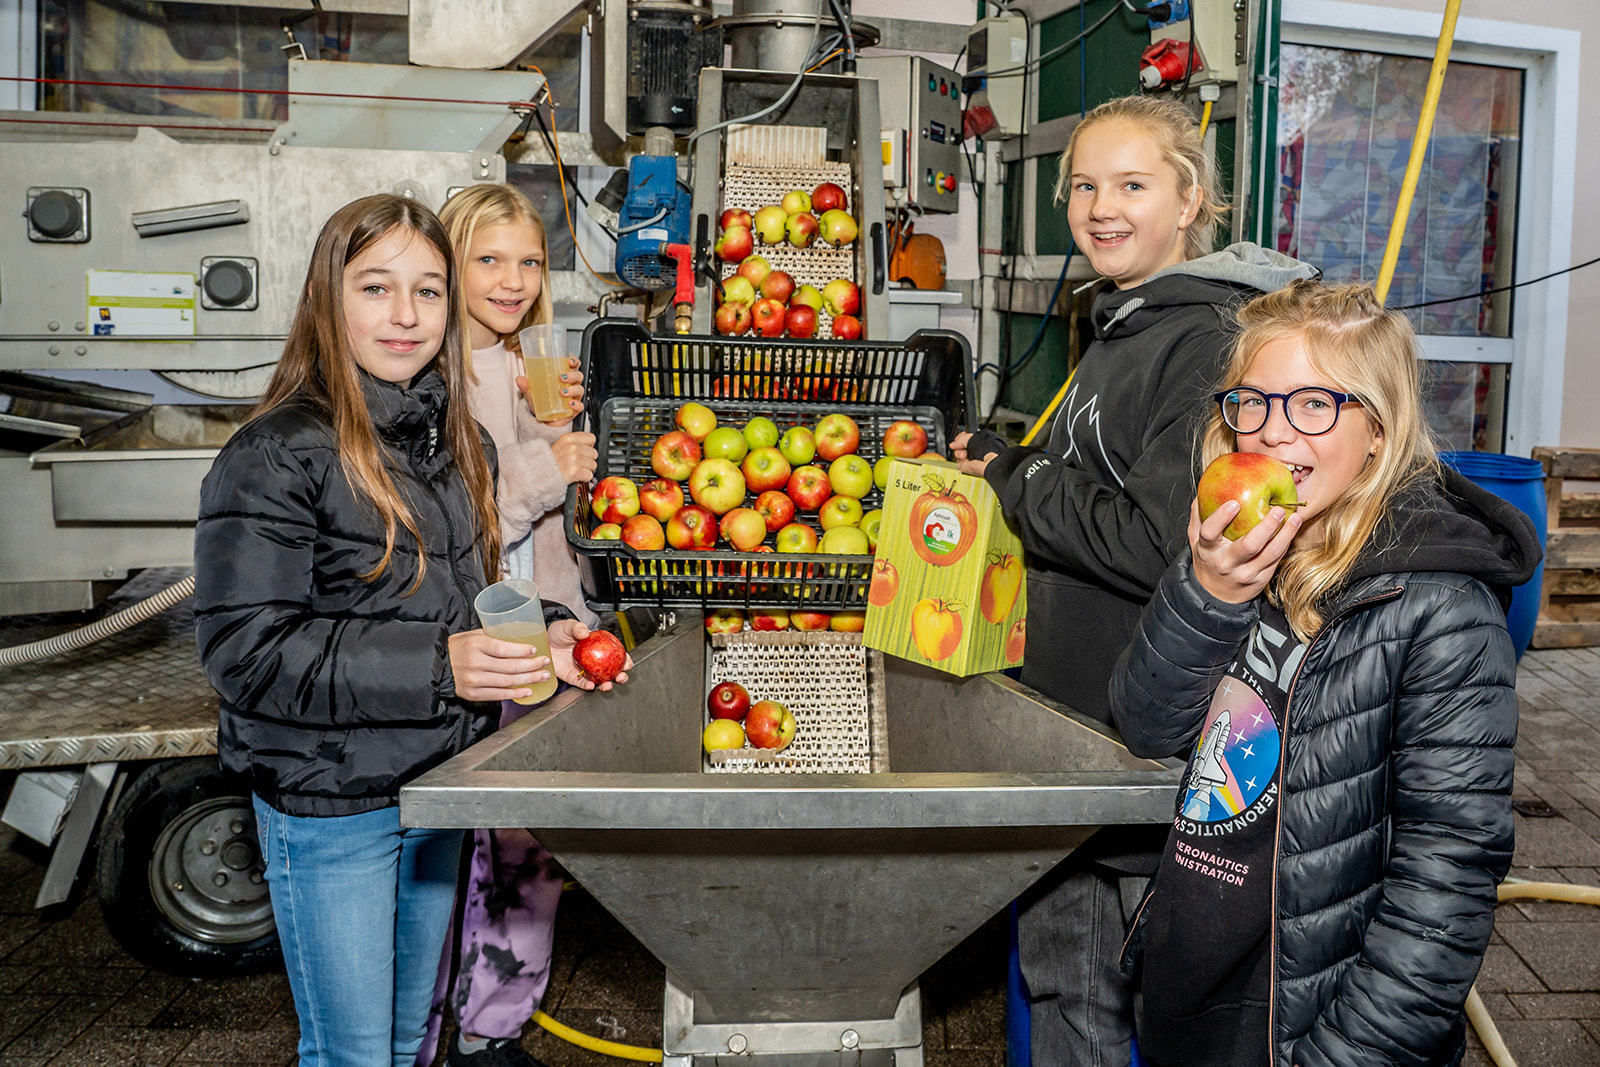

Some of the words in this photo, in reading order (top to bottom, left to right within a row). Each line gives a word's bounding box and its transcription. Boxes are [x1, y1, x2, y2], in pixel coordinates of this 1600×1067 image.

[895, 478, 901, 488] 5
[902, 480, 922, 492] Liter
[1242, 667, 1265, 696] THE
[1179, 782, 1279, 837] AERONAUTICS
